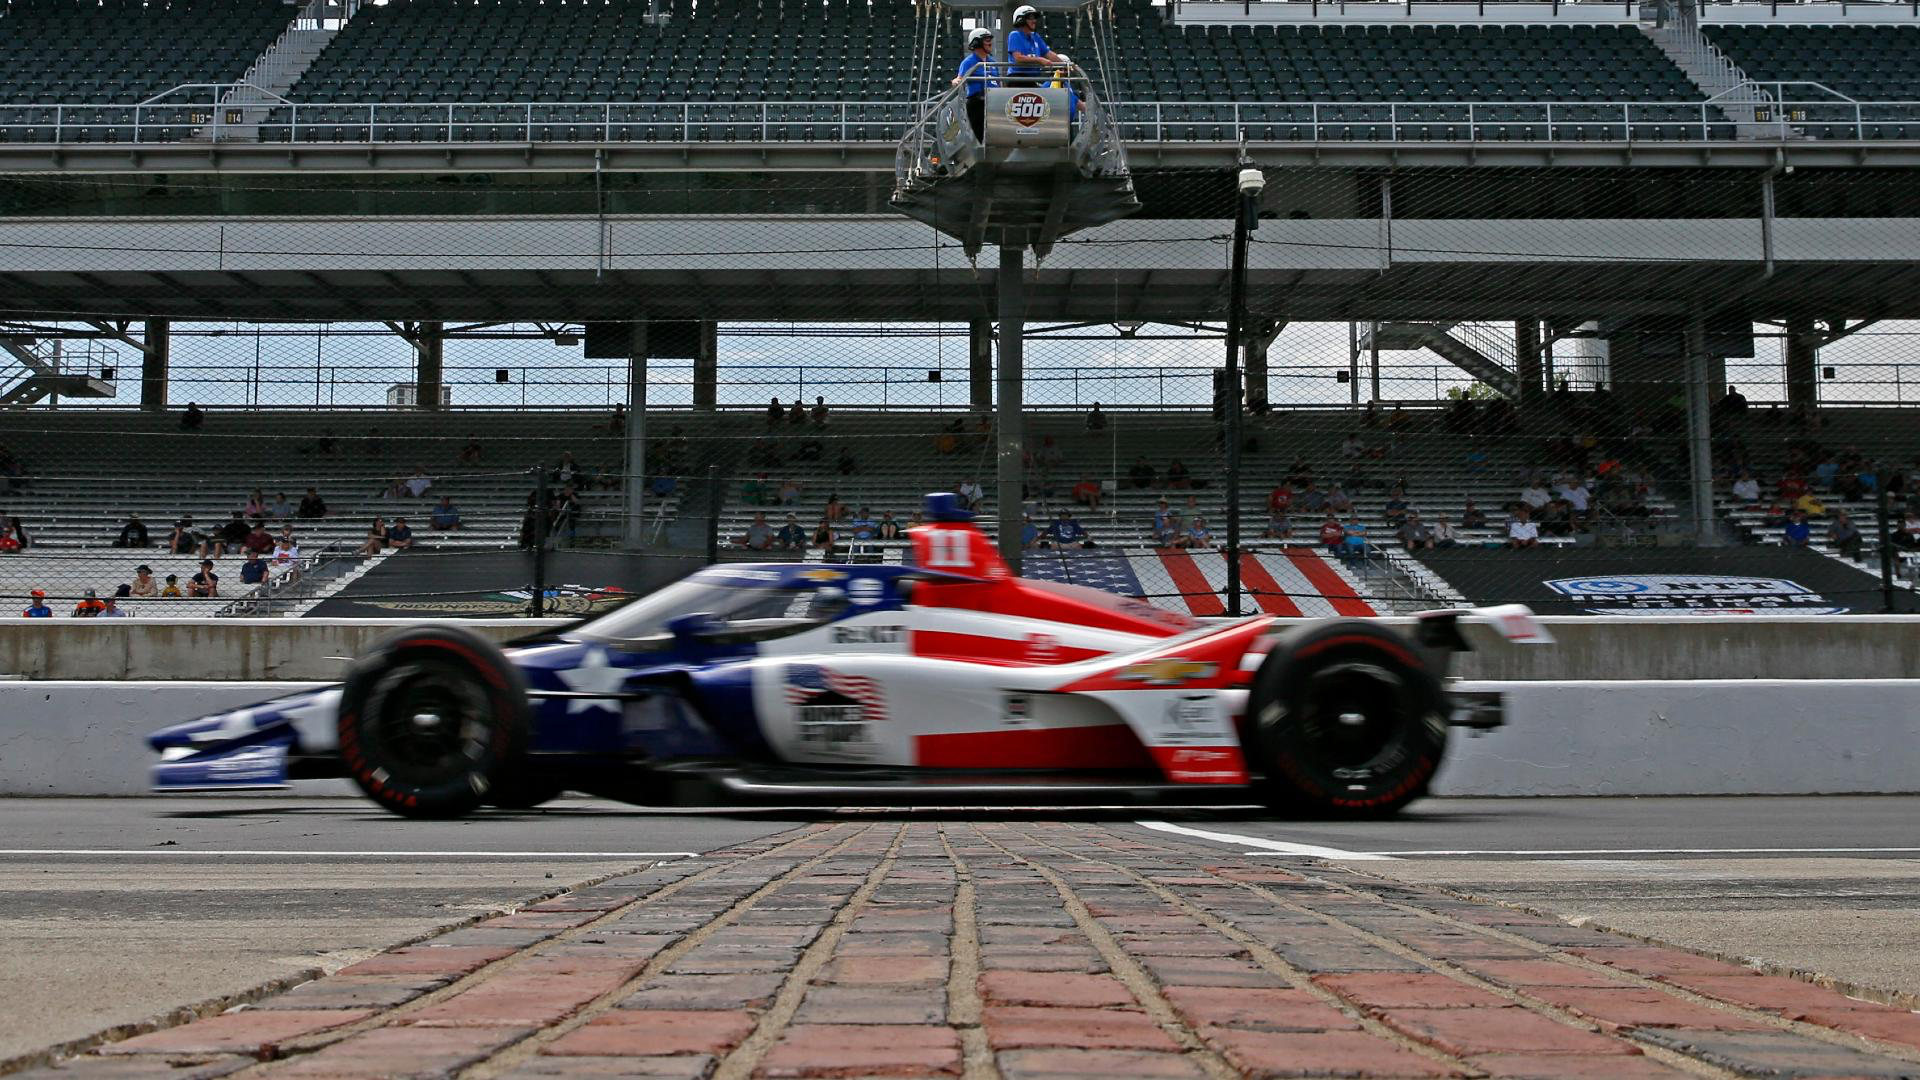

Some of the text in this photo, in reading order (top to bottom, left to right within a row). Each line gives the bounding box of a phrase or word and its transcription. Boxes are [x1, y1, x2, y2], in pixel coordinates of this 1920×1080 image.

[1010, 103, 1045, 117] 500
[927, 530, 974, 567] 11
[1660, 582, 1776, 590] NTT
